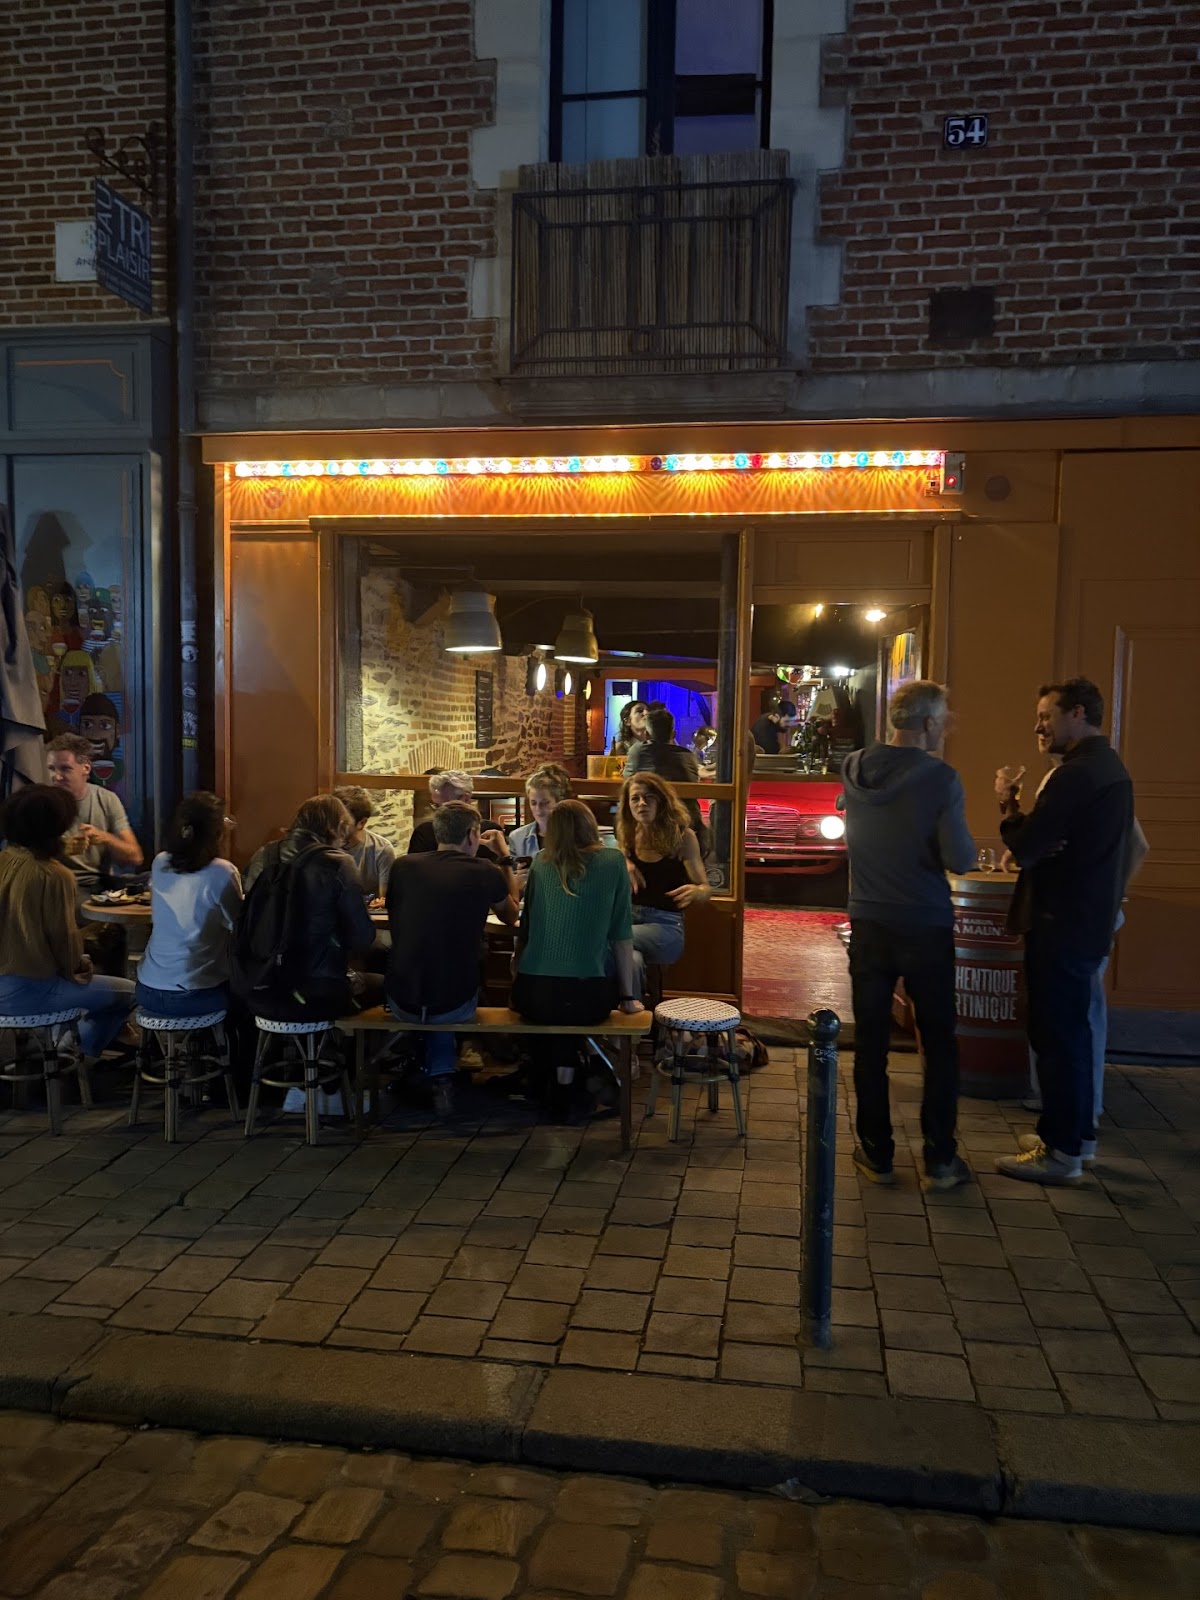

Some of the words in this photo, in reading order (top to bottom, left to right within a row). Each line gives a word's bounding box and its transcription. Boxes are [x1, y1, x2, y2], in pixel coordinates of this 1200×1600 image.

[947, 118, 985, 145] 54
[96, 183, 113, 235] AU
[113, 197, 151, 259] TRI
[97, 228, 151, 282] PLAISIR
[955, 965, 1019, 996] HENTIQUE
[955, 993, 1018, 1023] RTINIQUE
